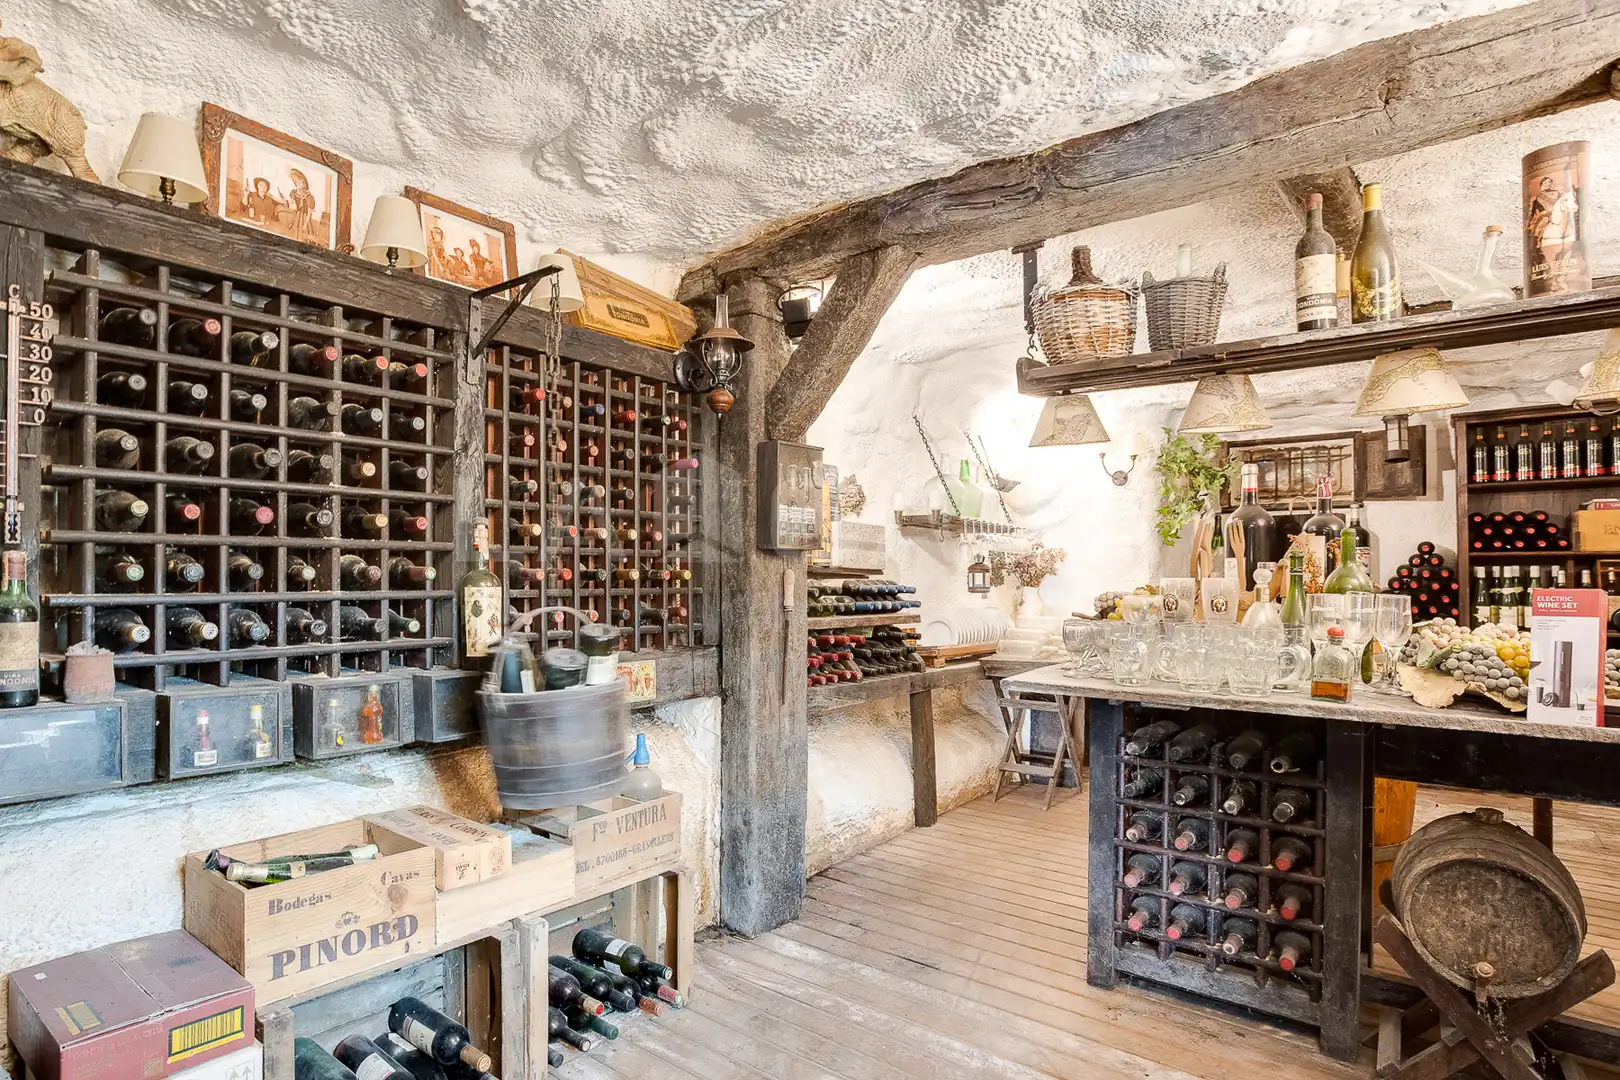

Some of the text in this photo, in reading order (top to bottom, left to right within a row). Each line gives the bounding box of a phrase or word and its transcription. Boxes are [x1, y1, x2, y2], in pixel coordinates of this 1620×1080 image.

[9, 284, 20, 298] C
[30, 303, 54, 319] 50
[30, 325, 53, 341] 40
[30, 346, 53, 361] 30
[29, 367, 53, 383] 20
[31, 387, 52, 403] 10
[33, 408, 46, 424] 0
[616, 803, 667, 834] VENTURA
[268, 889, 331, 916] Bodegas
[267, 913, 419, 981] PINORD
